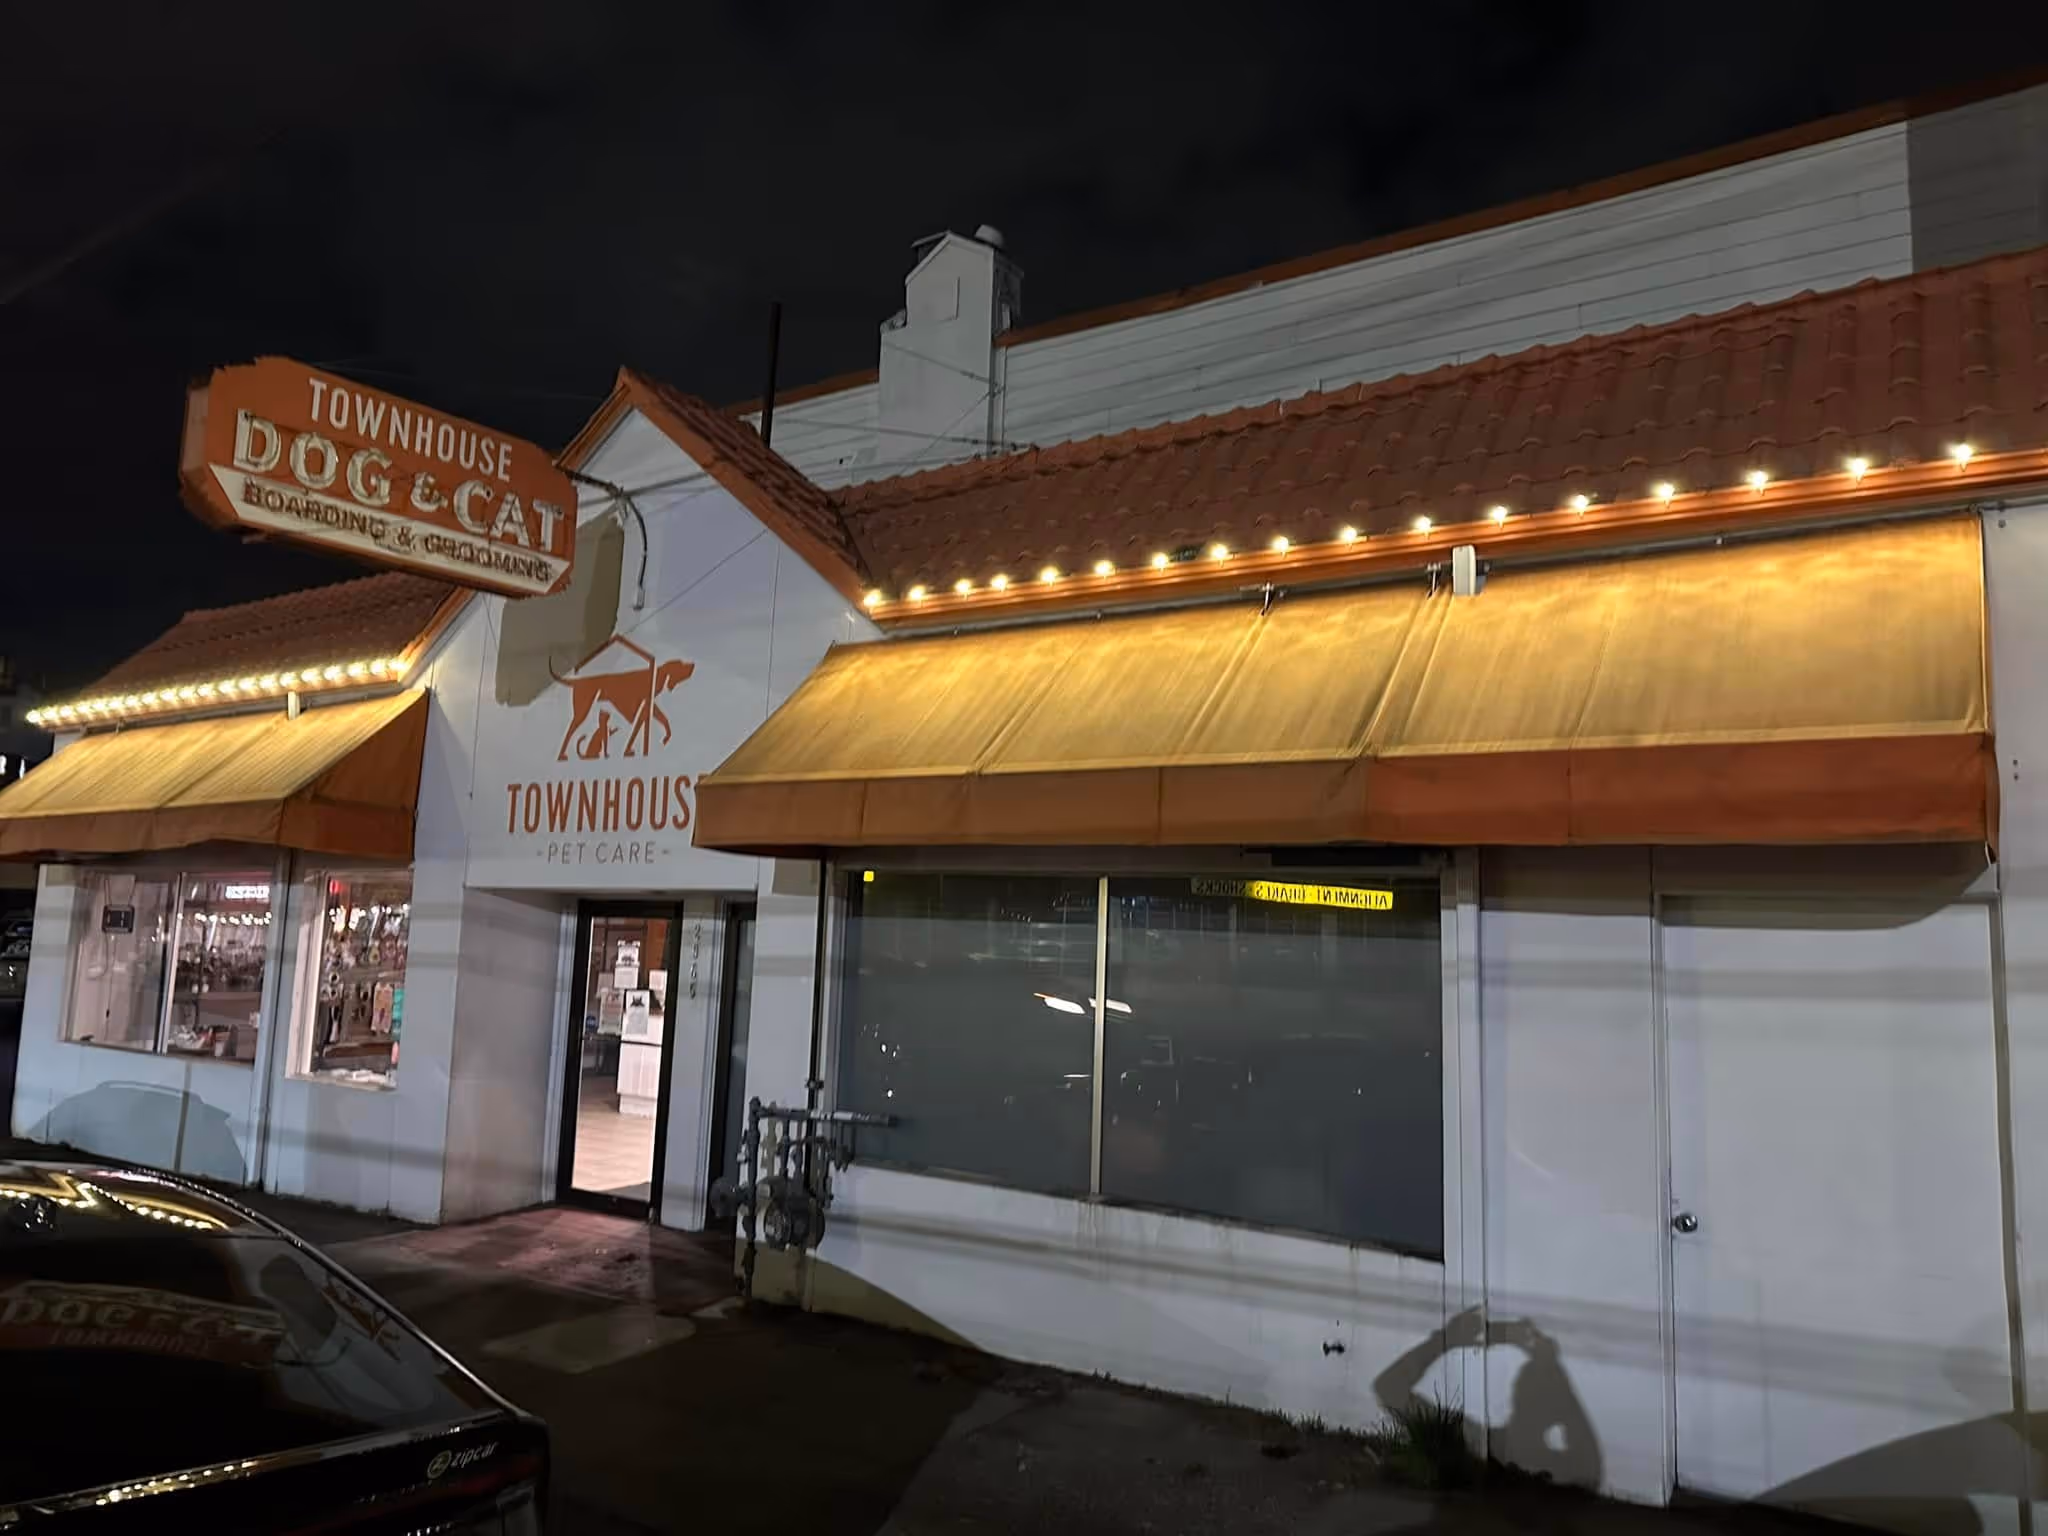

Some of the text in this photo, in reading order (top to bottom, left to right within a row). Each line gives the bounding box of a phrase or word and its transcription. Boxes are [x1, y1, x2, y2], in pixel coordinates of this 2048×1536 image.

[233, 408, 564, 552] DOG & CAT
[309, 377, 513, 483] TOWNHOUSE
[243, 476, 386, 541] BOARDING
[423, 533, 553, 583] GROOMING
[507, 774, 708, 834] TOWNHOUS
[451, 1441, 499, 1468] zipcar
